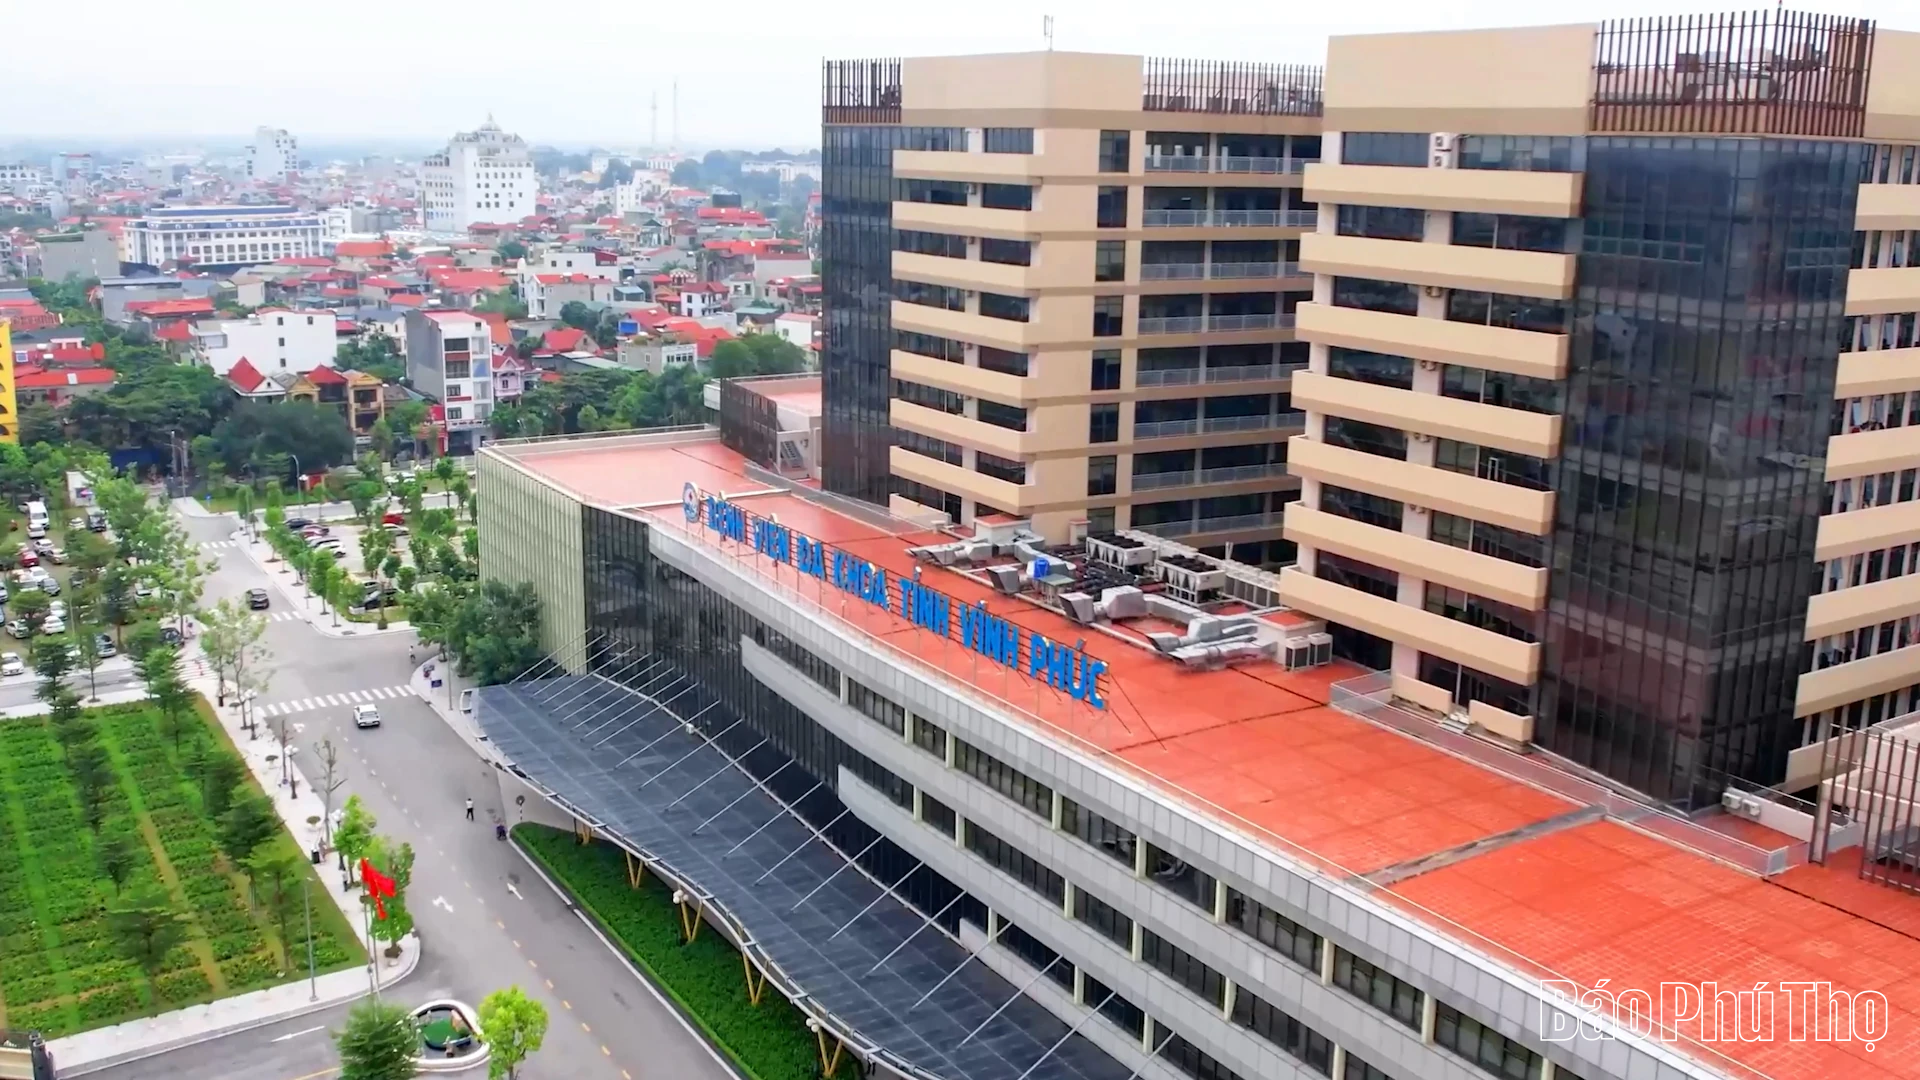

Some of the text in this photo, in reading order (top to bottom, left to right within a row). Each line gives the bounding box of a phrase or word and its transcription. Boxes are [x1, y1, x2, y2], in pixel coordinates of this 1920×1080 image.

[797, 534, 826, 581] ĐA
[832, 550, 890, 611] KHOA
[898, 566, 949, 638] TỈNH
[959, 599, 1019, 670] VĨNH
[1030, 633, 1108, 710] PHÚC
